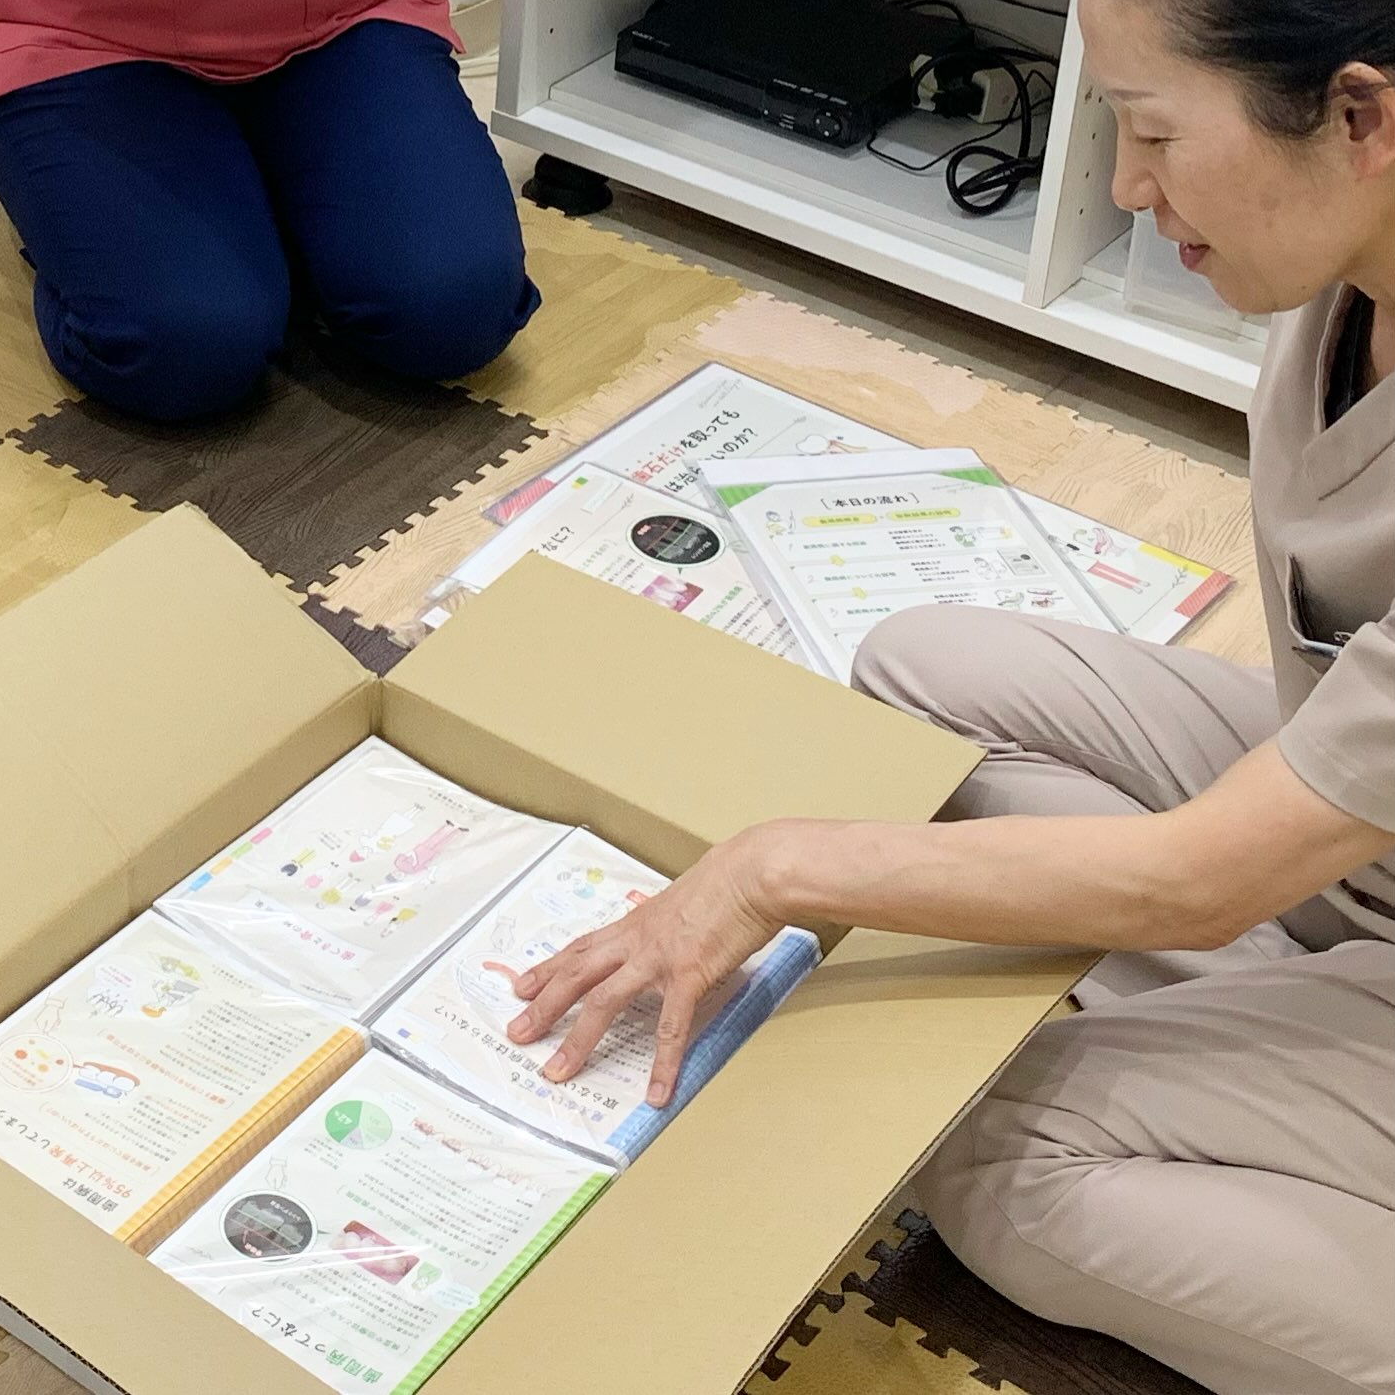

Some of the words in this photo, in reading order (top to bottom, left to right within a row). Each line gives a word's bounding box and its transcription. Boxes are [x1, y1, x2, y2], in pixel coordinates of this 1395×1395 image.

[664, 427, 758, 493] は治らいのか?
[434, 1006, 620, 1110] 取らない周病は治らない?
[62, 1177, 119, 1213] 歯周病は
[250, 1305, 384, 1384] 歯周病ってなに?
